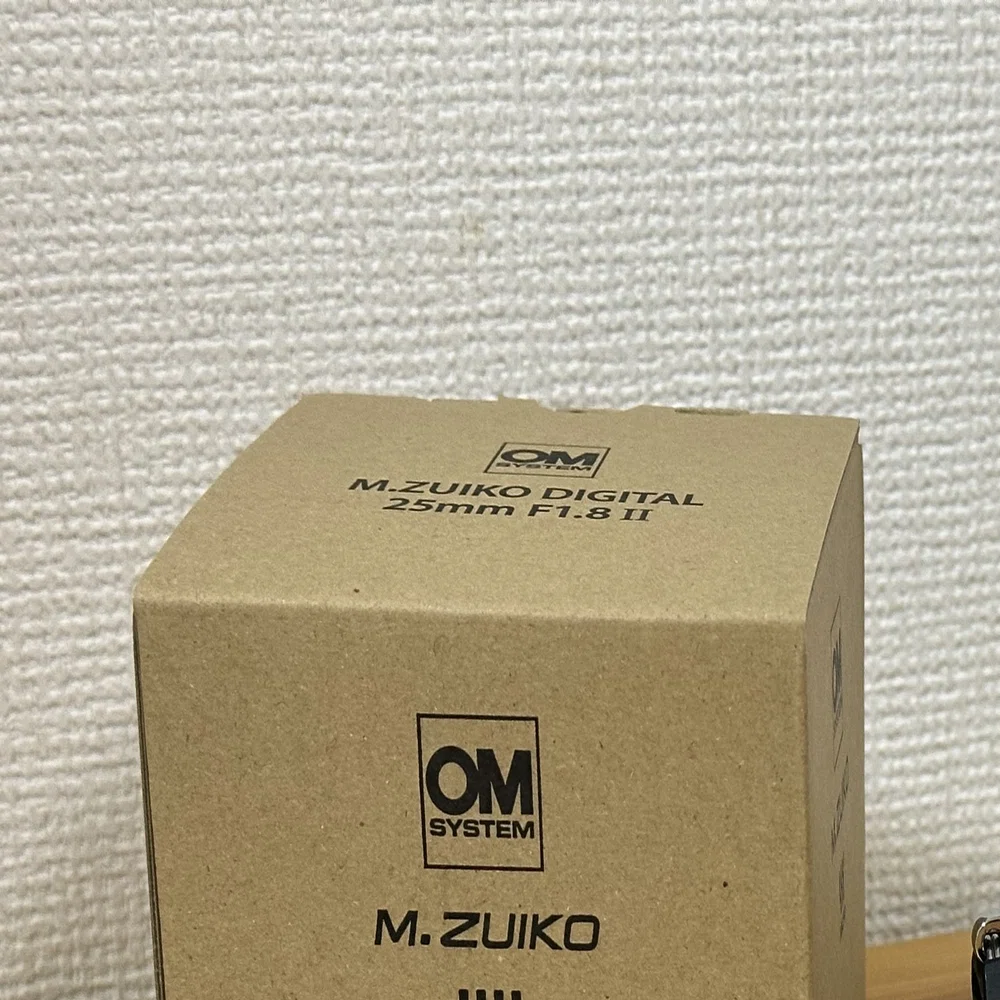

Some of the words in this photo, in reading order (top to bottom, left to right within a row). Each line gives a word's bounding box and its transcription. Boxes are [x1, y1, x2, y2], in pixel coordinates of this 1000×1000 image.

[495, 461, 593, 472] SYSTEM
[499, 449, 601, 466] OM
[348, 478, 532, 499] M.ZUIKO
[540, 487, 704, 507] DIGITAL
[382, 497, 514, 517] 25mm
[526, 504, 612, 521] F1.8
[425, 745, 534, 816] OM
[429, 817, 535, 840] SYSTEM
